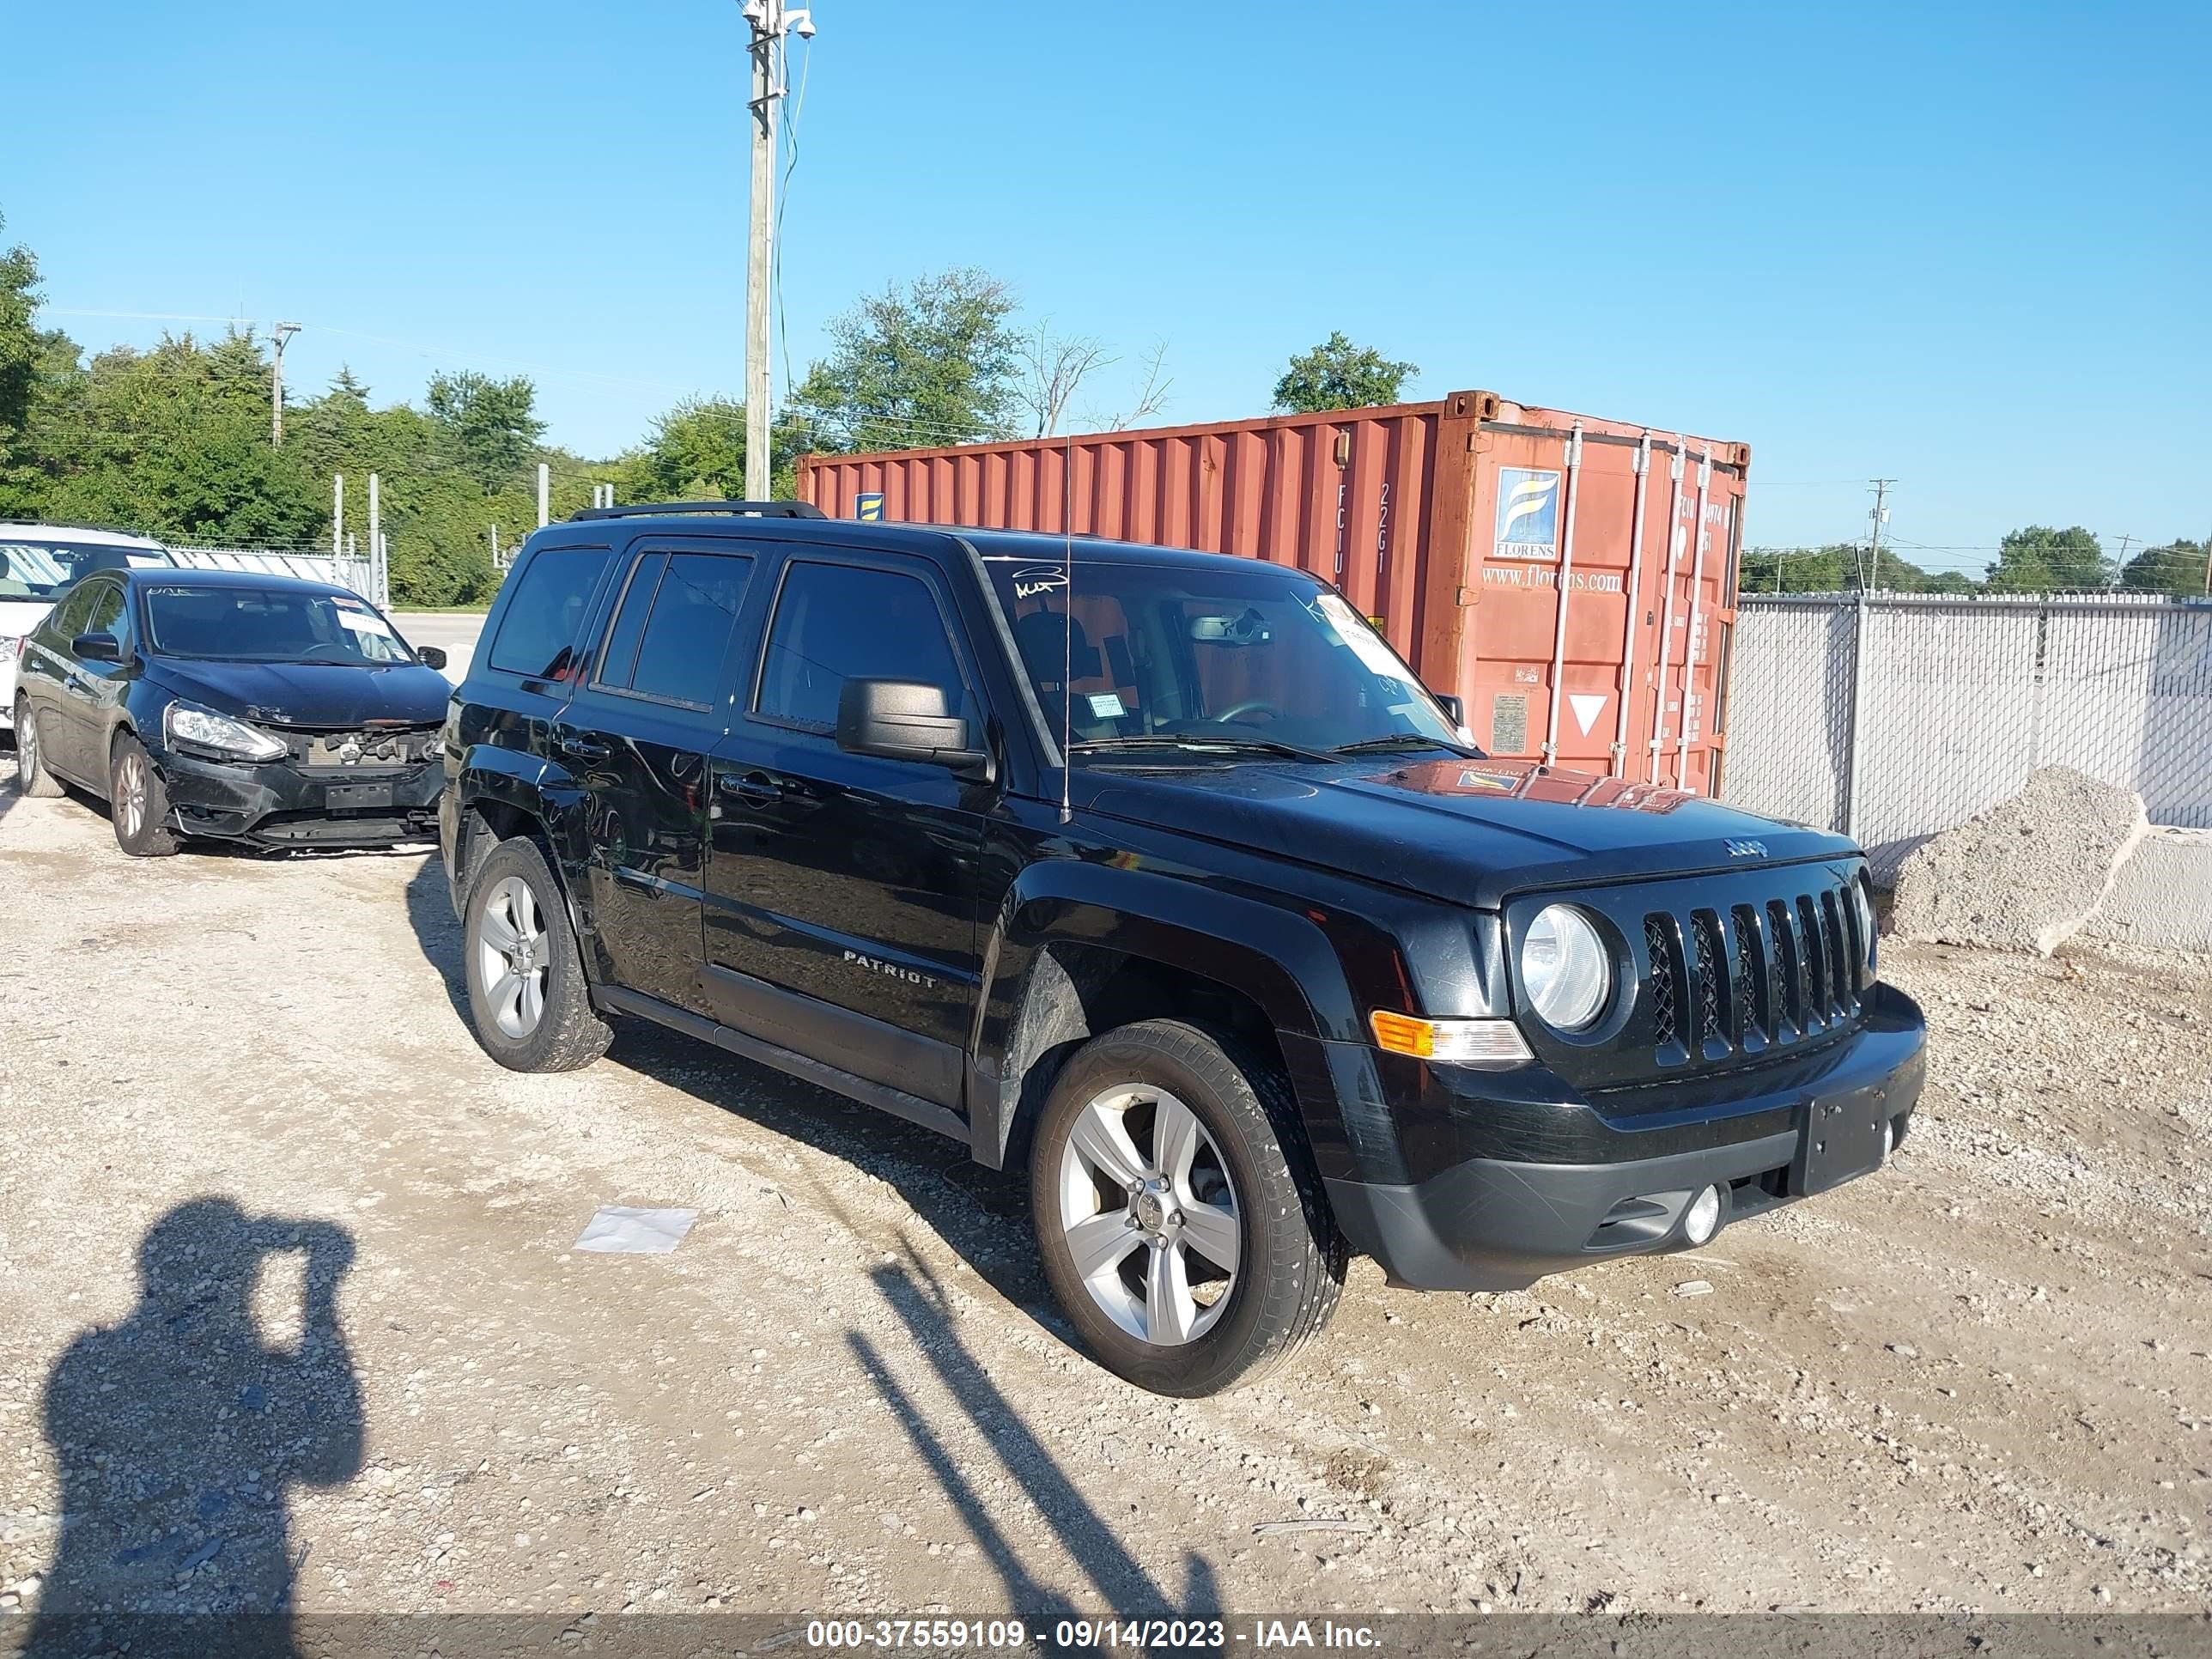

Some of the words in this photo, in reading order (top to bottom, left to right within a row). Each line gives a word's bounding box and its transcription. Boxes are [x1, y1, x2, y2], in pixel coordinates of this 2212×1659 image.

[1334, 484, 1346, 574] FCIU
[1377, 483, 1390, 574] 22G1
[1495, 543, 1554, 557] FLORENS
[1482, 563, 1621, 592] www.florens.com
[1723, 838, 1769, 858] Jeep
[844, 950, 937, 988] PATRIOT
